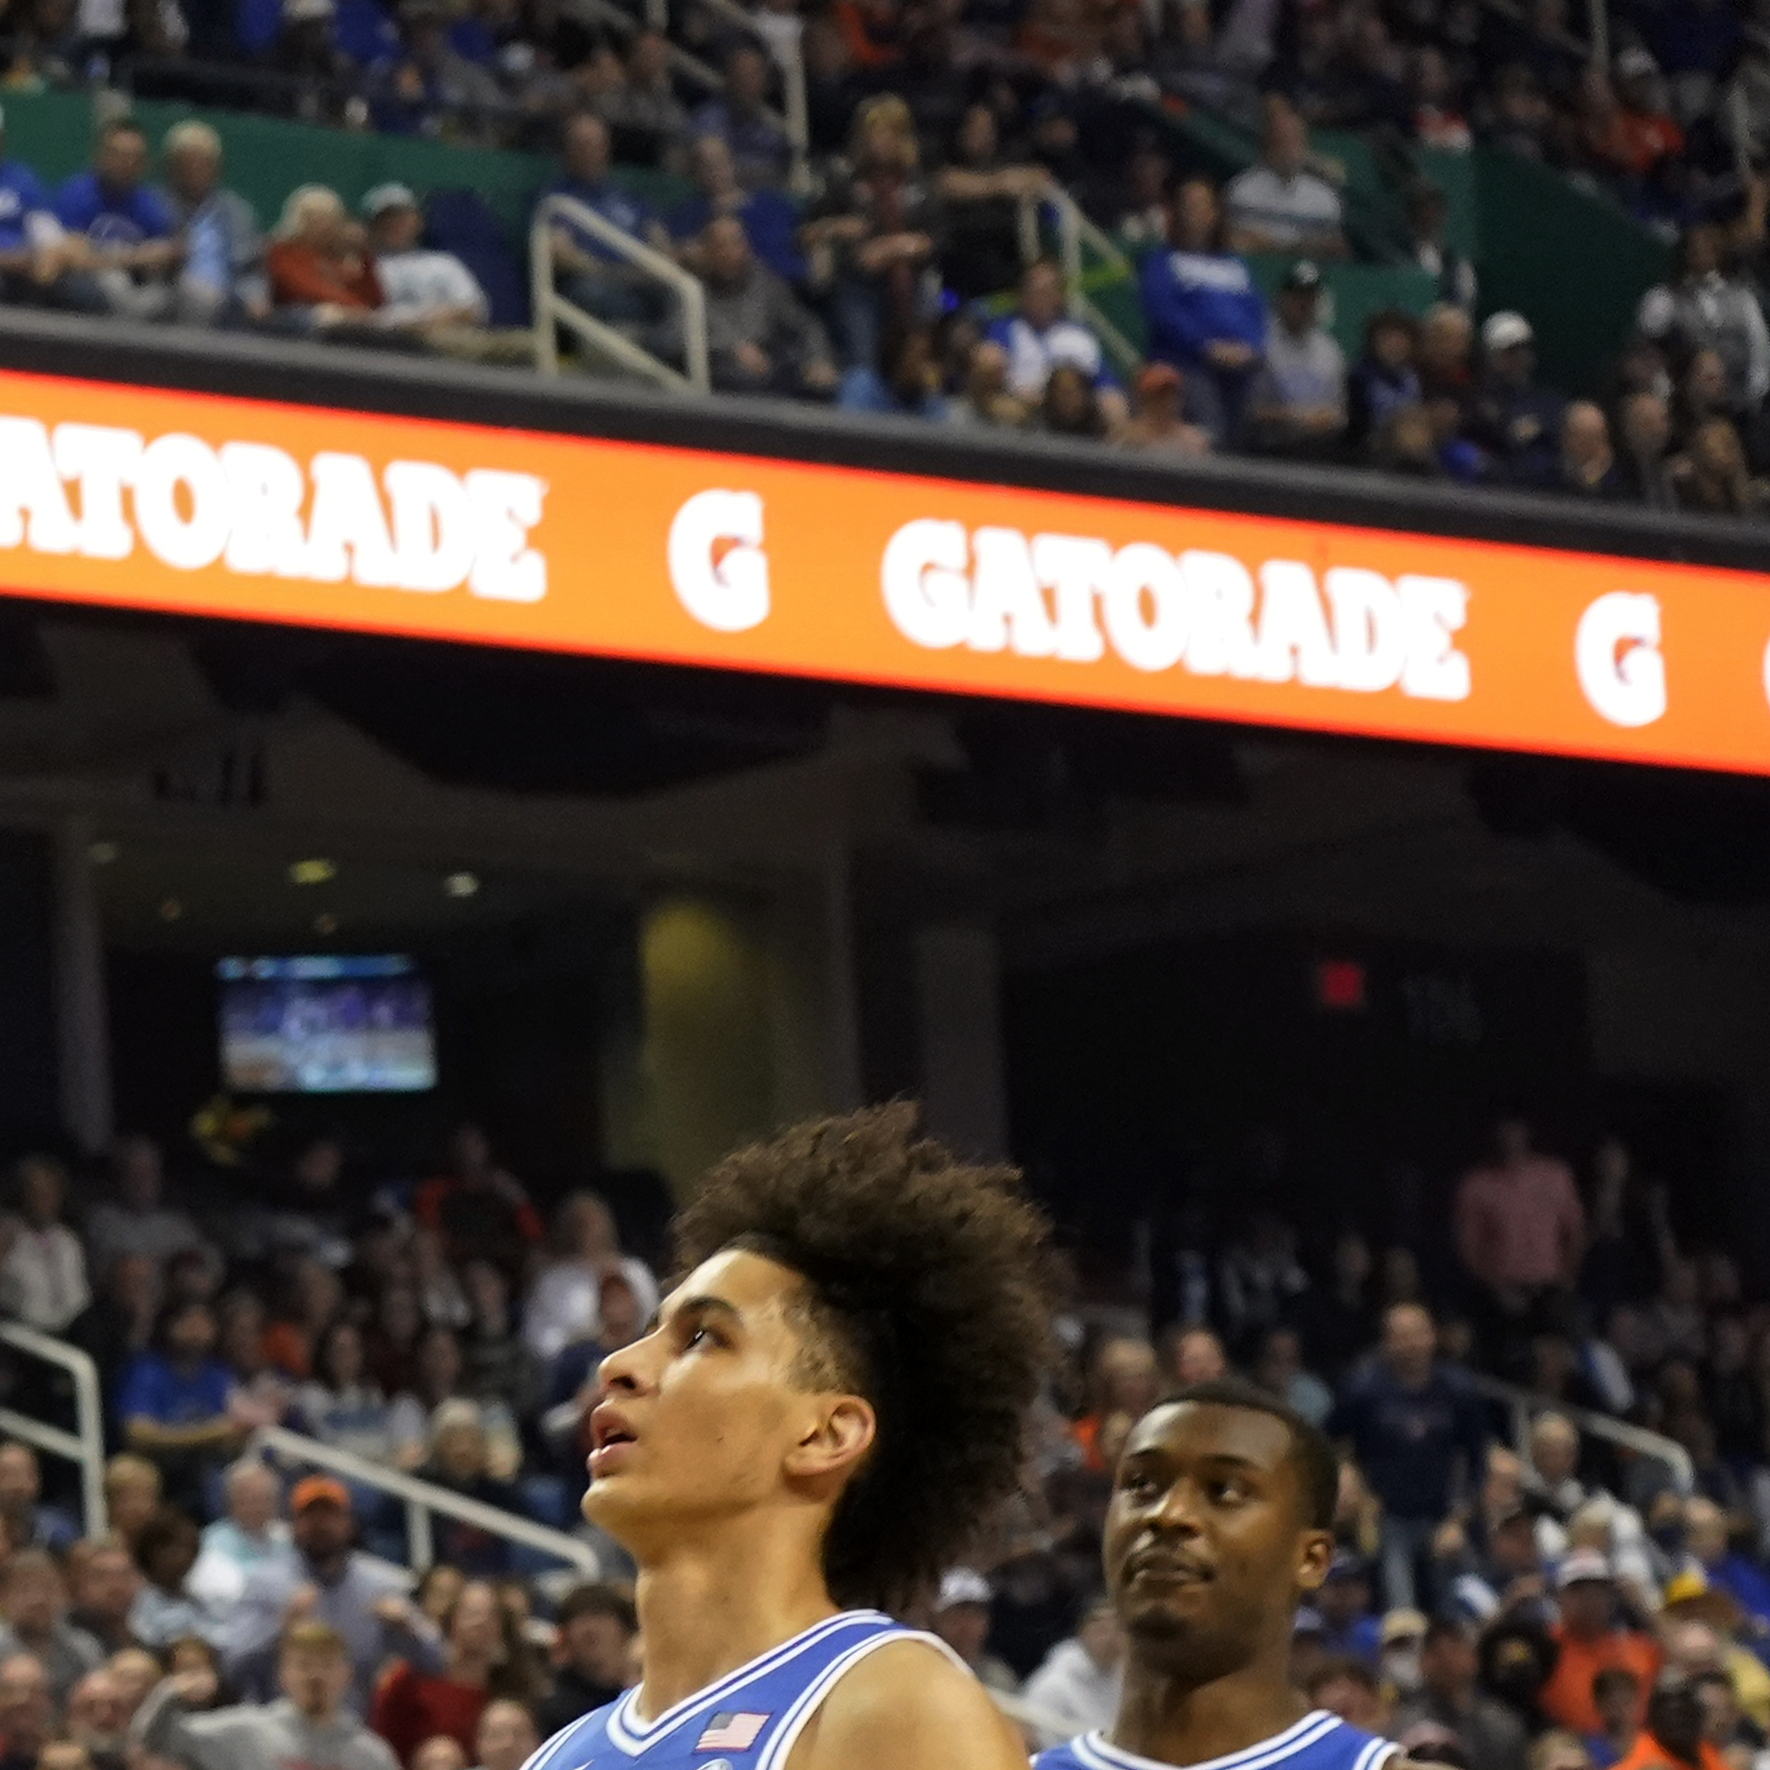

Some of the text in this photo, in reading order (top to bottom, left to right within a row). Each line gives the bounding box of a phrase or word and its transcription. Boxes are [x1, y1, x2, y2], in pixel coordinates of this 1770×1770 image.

[667, 488, 770, 632] G
[880, 518, 1471, 701] GATORADE
[1574, 591, 1667, 728] G
